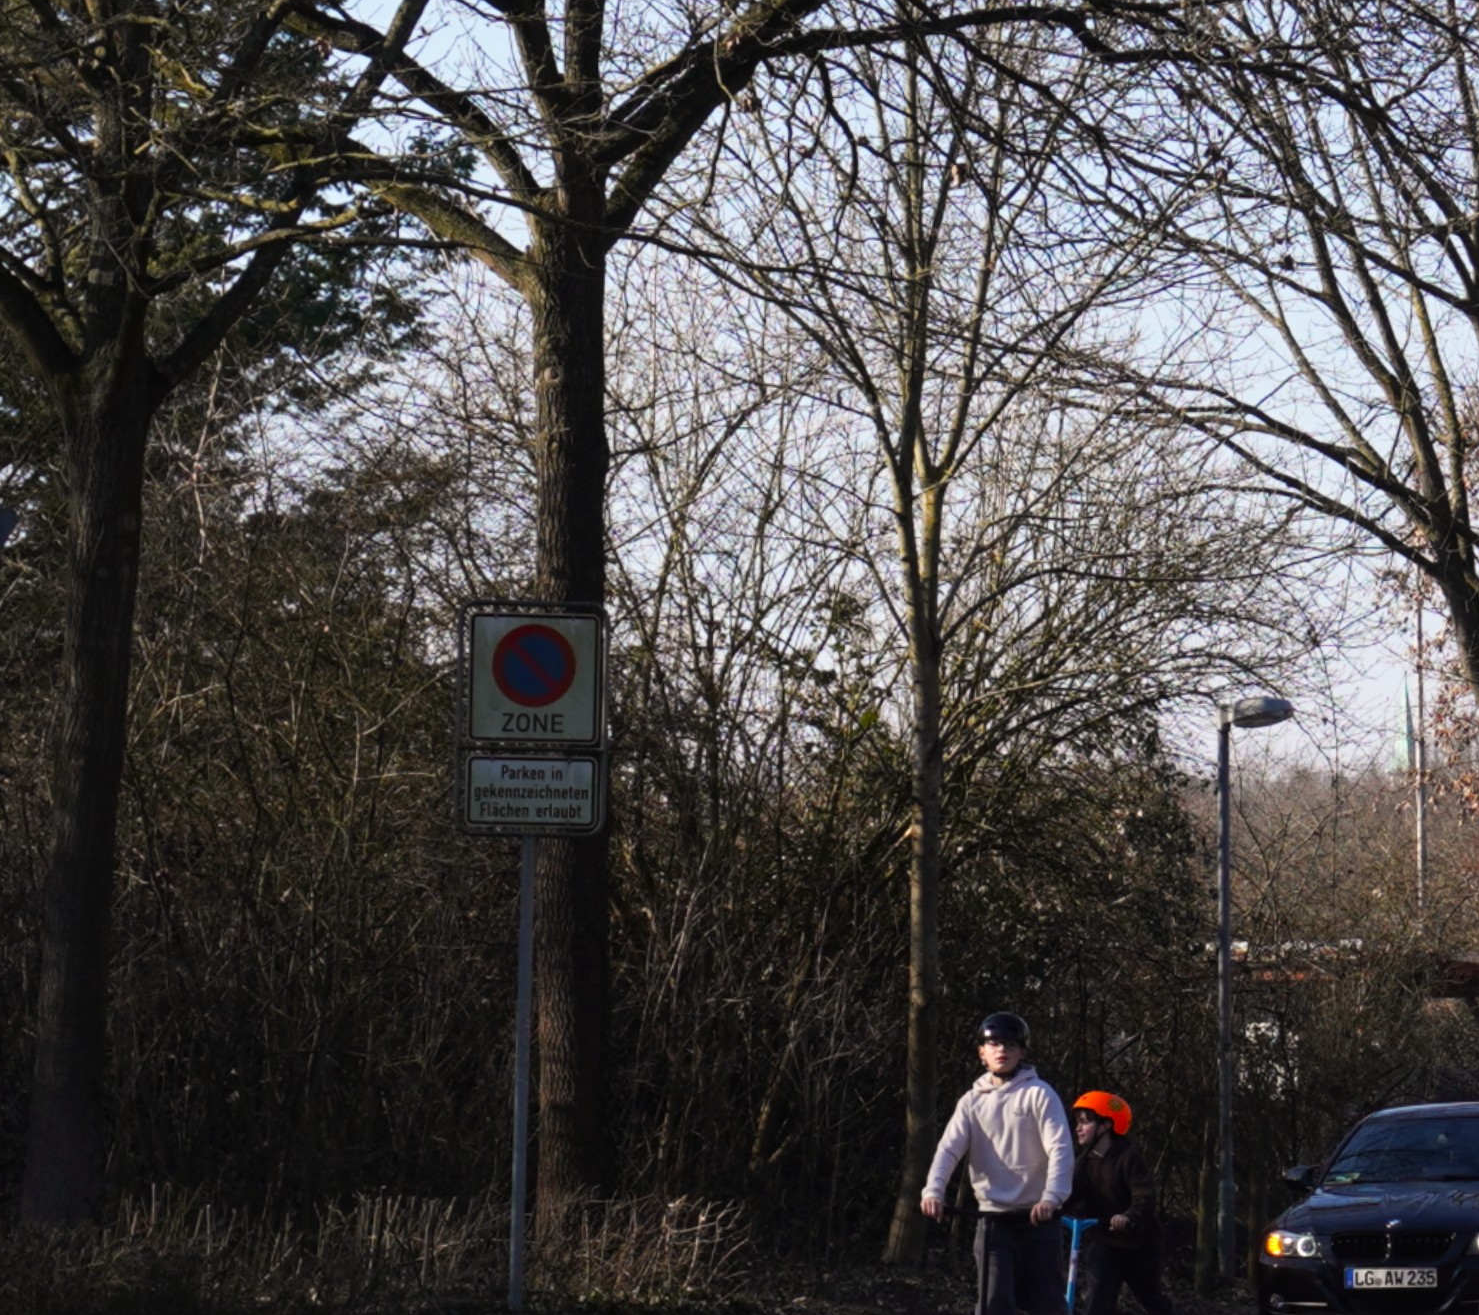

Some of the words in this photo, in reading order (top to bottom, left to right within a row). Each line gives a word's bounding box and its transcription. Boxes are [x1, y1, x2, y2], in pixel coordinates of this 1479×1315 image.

[501, 713, 564, 733] ZONE
[501, 764, 545, 780] Parken
[551, 765, 563, 781] in
[474, 784, 589, 801] gekennzeichneten
[480, 801, 530, 818] Flächen
[536, 803, 582, 818] erlaubt
[1355, 1270, 1375, 1286] LG
[1385, 1270, 1404, 1286] AW
[1407, 1270, 1436, 1286] 235
